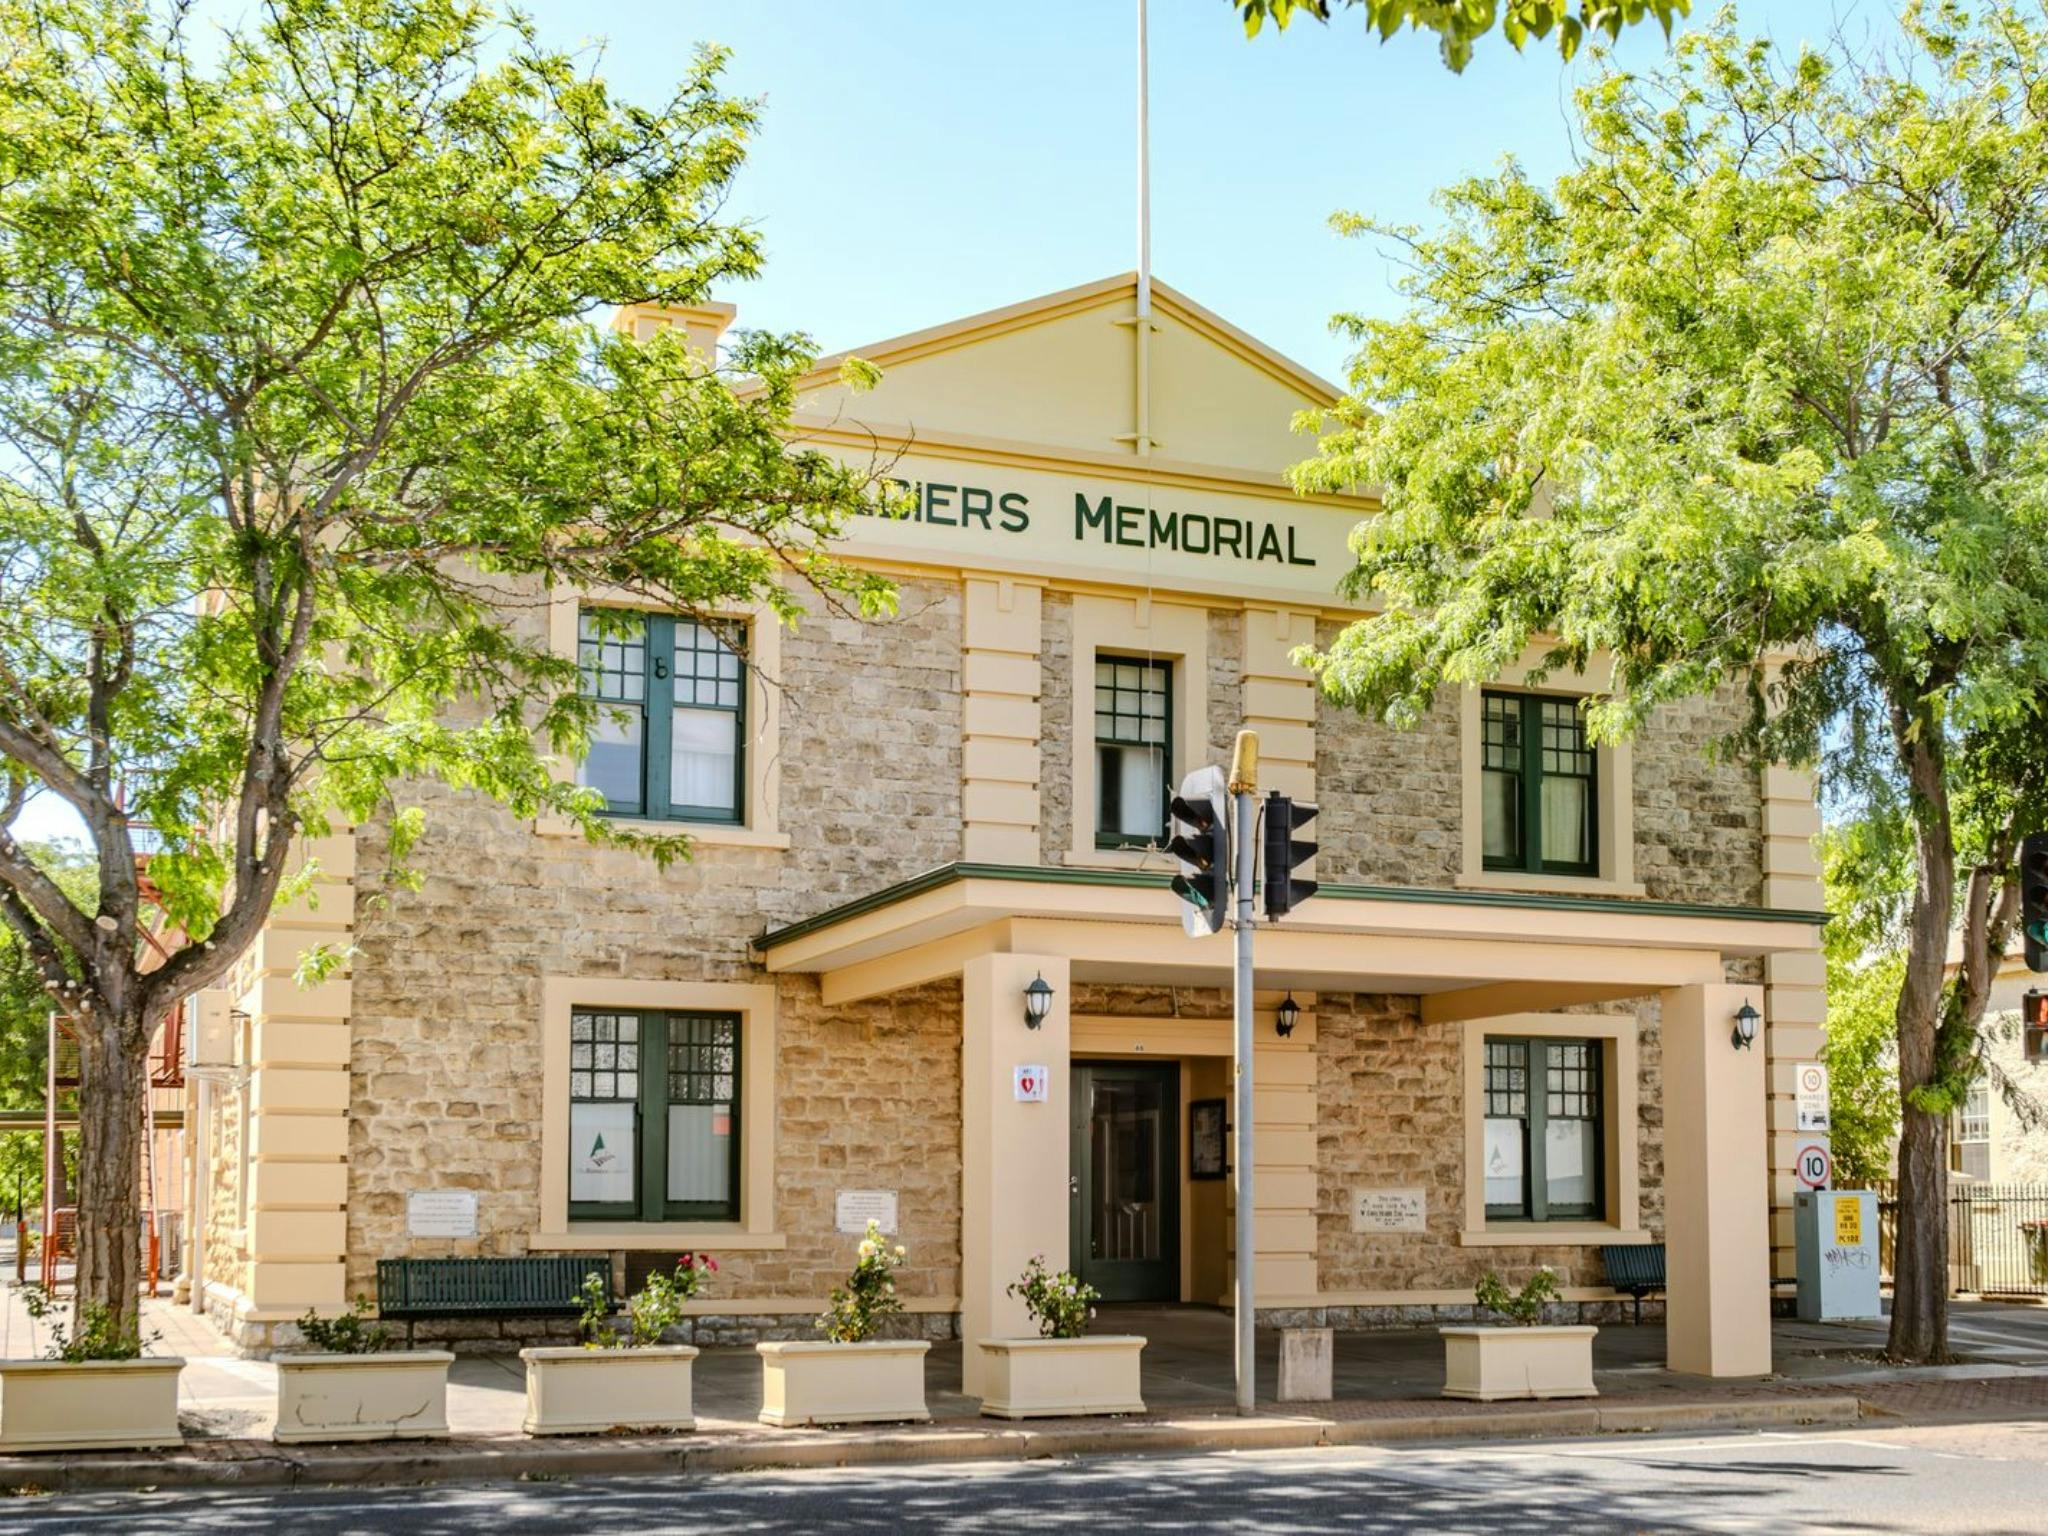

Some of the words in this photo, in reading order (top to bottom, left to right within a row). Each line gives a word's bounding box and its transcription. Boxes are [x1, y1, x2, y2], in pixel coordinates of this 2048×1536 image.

[855, 478, 1029, 533] DIERS
[1074, 492, 1316, 566] MEMORIAL
[1806, 1156, 1824, 1177] 10
